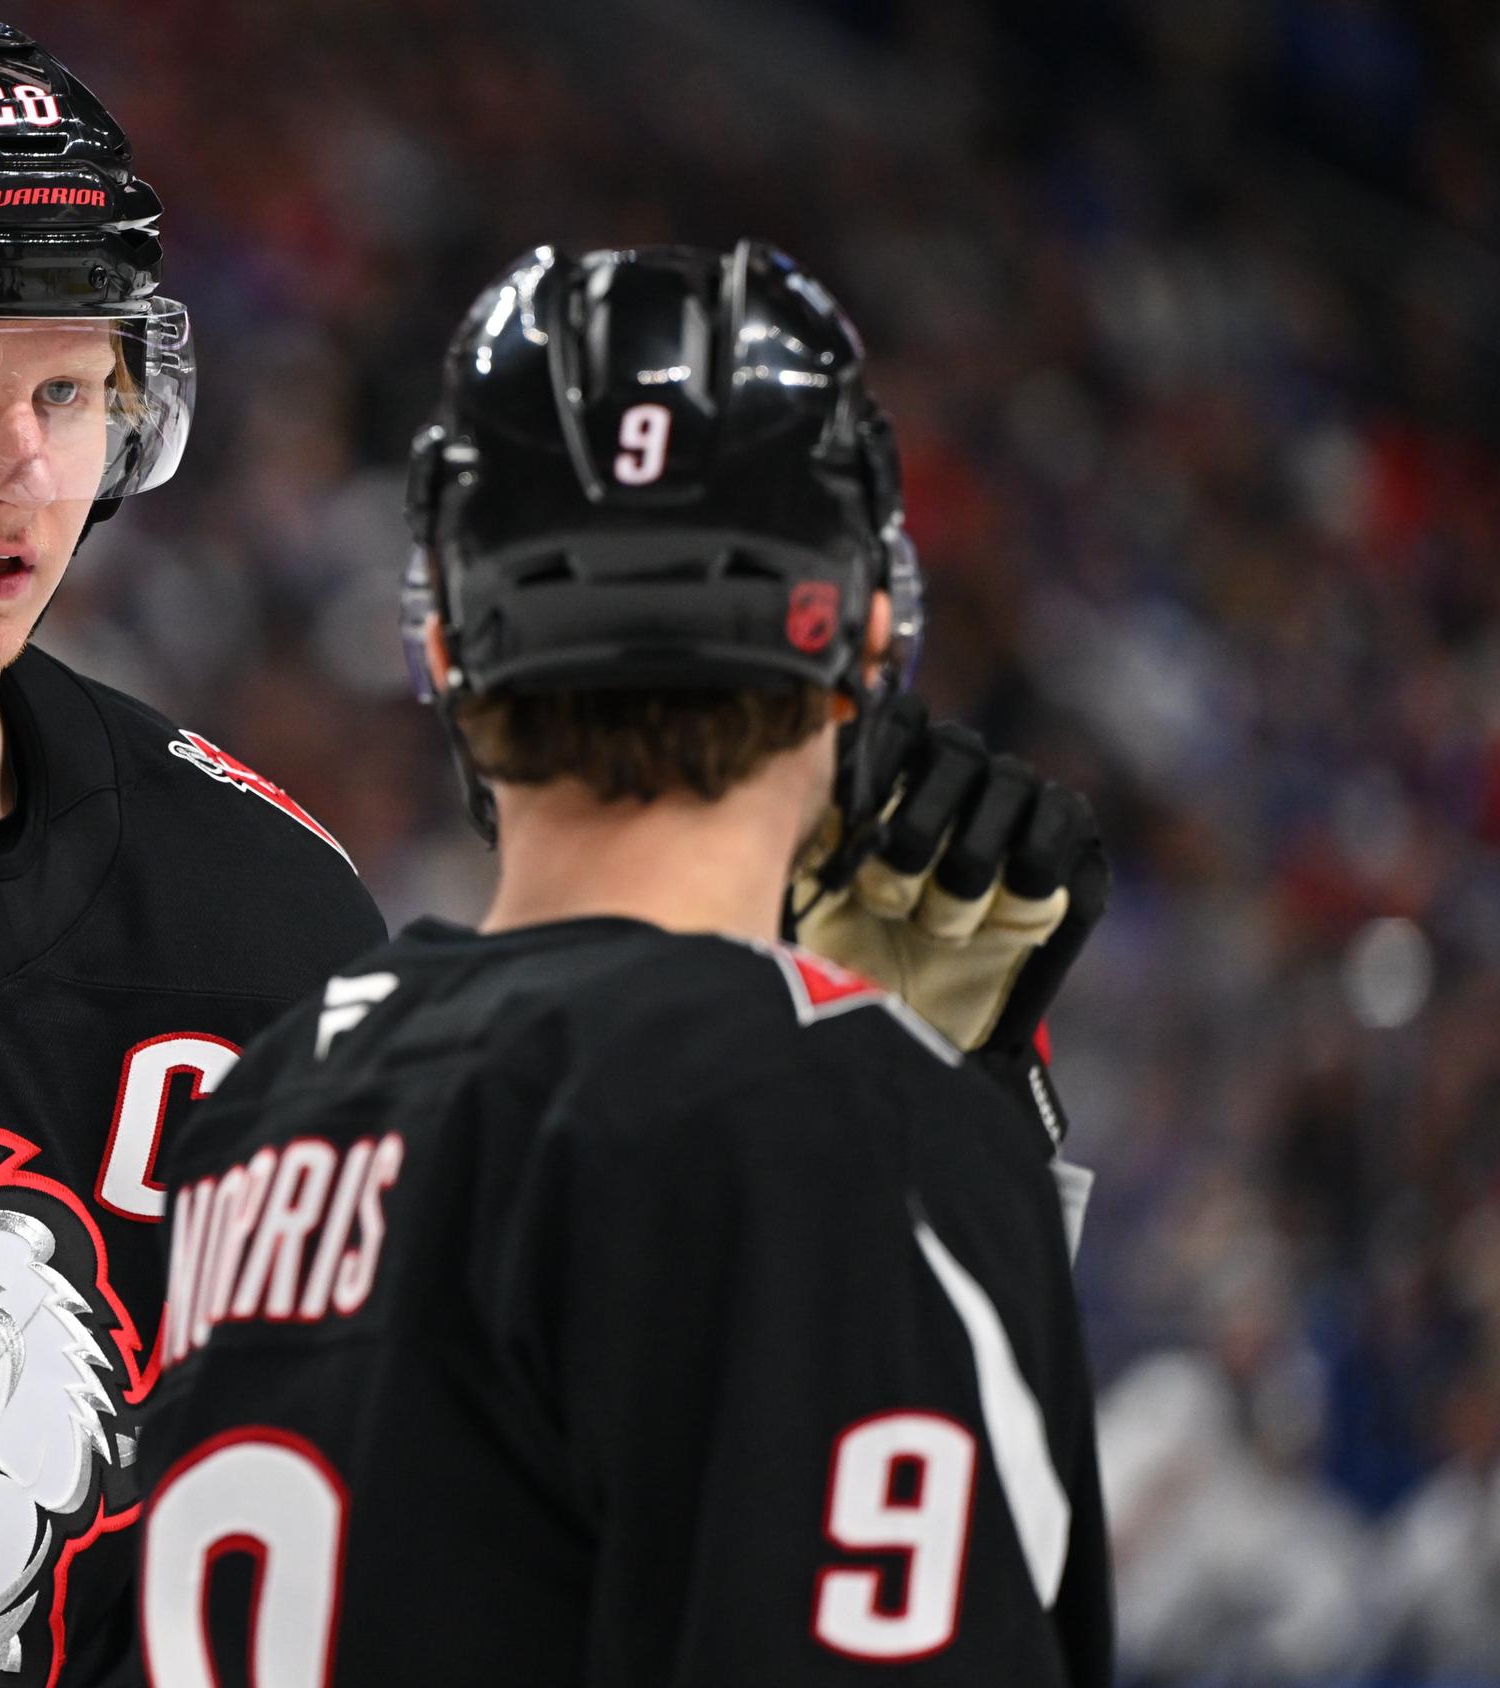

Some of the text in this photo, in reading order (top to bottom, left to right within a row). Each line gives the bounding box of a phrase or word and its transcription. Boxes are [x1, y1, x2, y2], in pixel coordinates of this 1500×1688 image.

[613, 403, 673, 486] 9
[94, 1031, 244, 1223] C
[809, 1406, 980, 1665] 9
